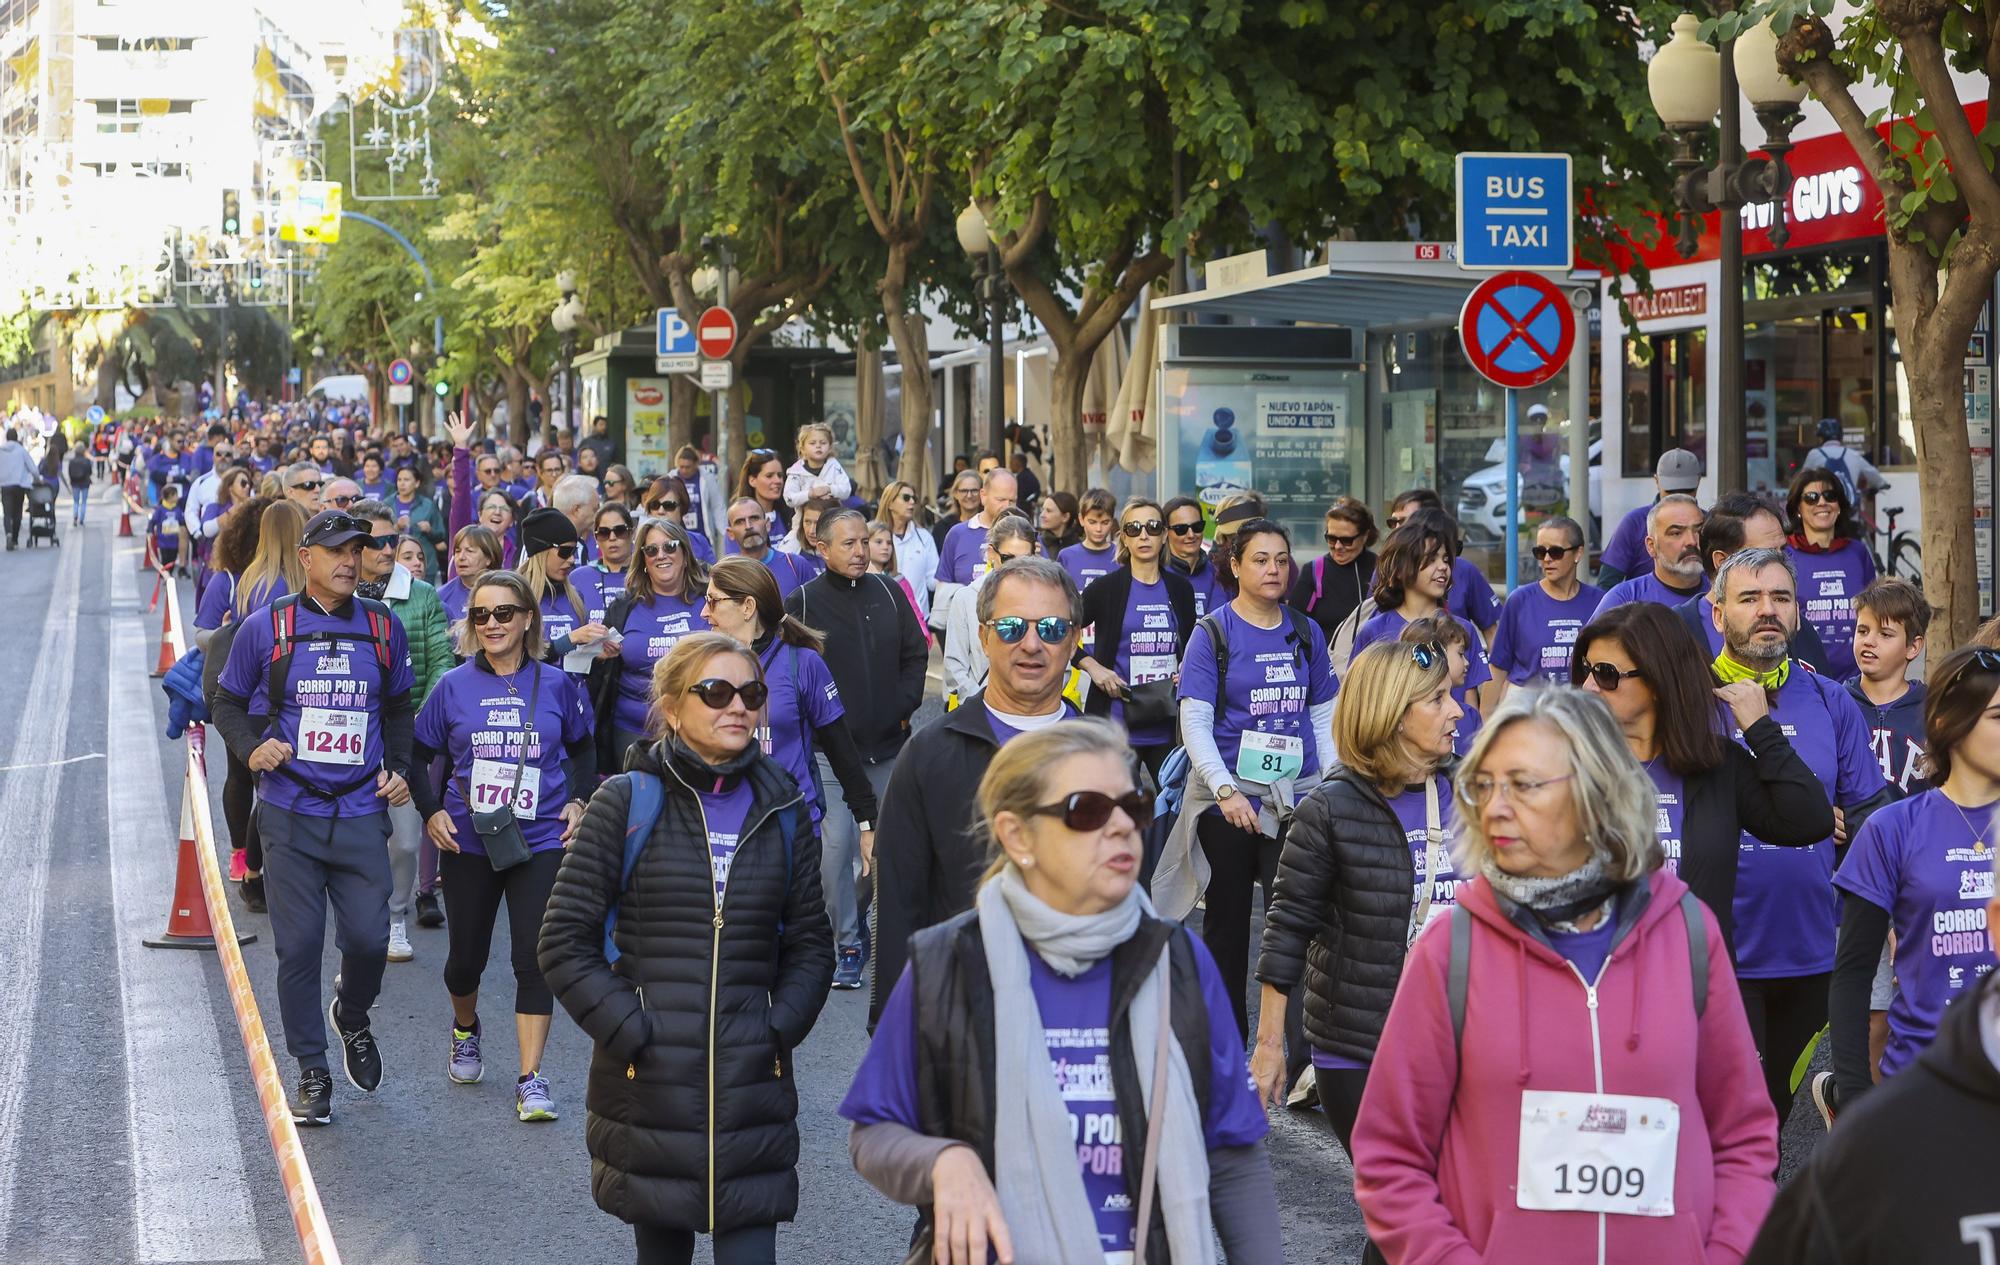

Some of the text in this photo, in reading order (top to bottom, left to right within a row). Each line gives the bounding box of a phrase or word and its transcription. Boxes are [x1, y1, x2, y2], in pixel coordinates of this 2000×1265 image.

[1487, 176, 1544, 198] BUS
[1793, 166, 1860, 222] GUYS
[1486, 225, 1548, 247] TAXI
[1420, 246, 1434, 258] 05
[1660, 287, 1704, 314] COLLECT
[665, 314, 689, 351] P
[1269, 400, 1333, 412] NUEVO TAPÓN
[1268, 415, 1334, 426] UNIDO AL BRIK
[1807, 599, 1849, 611] CORRO POR
[649, 637, 676, 647] CORRO
[1131, 632, 1172, 643] CORRO POR
[1542, 646, 1567, 658] CORRO
[297, 679, 368, 694] CORRO POR TI
[1251, 687, 1281, 703] CORRO
[1283, 686, 1300, 700] POR
[295, 693, 329, 707] CORRO
[332, 693, 353, 707] POR
[1250, 699, 1298, 716] CORRO POR
[305, 731, 362, 755] 1246
[471, 731, 503, 745] CORRO
[530, 732, 539, 745] TI
[472, 745, 501, 758] CORRO
[1261, 754, 1283, 772] 81
[1868, 728, 1926, 793] AP
[1661, 839, 1681, 858] OR
[1933, 907, 1987, 934] CORRO
[1931, 931, 1984, 957] CORRO
[1077, 1144, 1123, 1176] POR
[1554, 1163, 1645, 1198] 1909
